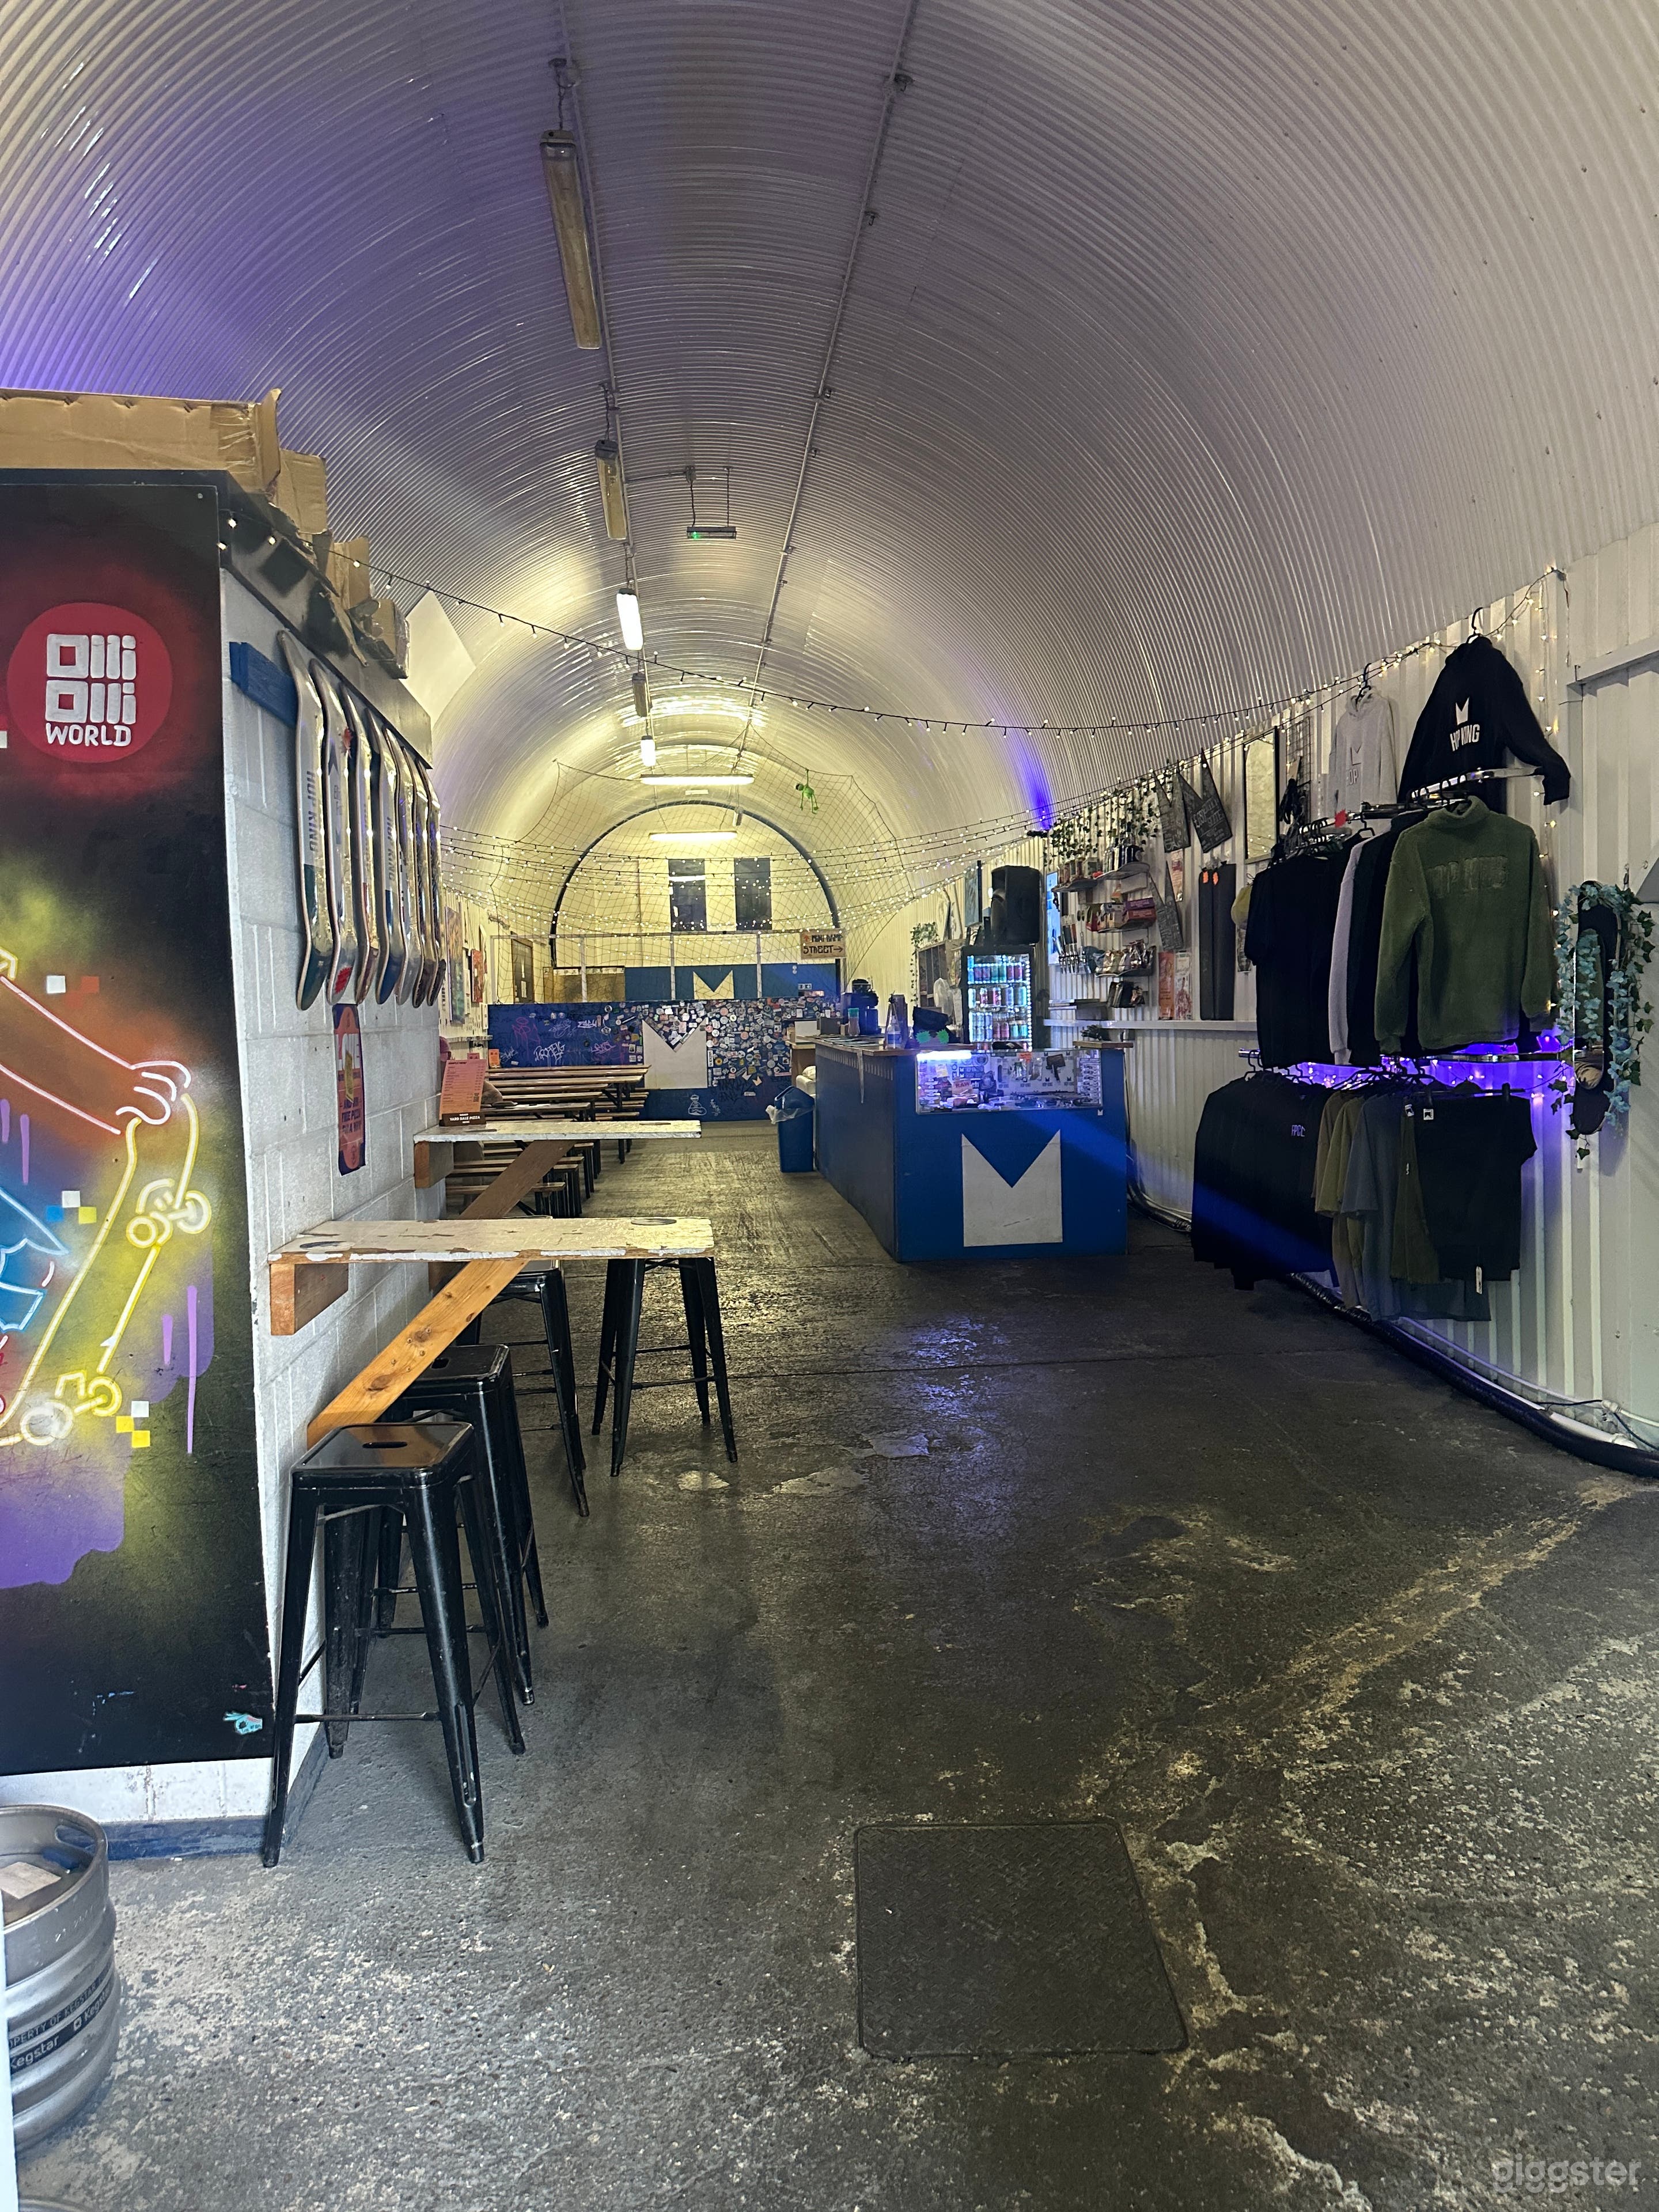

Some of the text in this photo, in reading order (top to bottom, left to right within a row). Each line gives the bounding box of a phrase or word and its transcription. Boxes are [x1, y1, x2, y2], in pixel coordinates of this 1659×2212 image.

[46, 722, 132, 747] WORLD
[308, 809, 319, 853] KING
[803, 945, 834, 954] STREET
[50, 2012, 63, 2027] OF
[64, 1983, 97, 2018] KEGSTAR
[84, 1985, 109, 2021] Kegst
